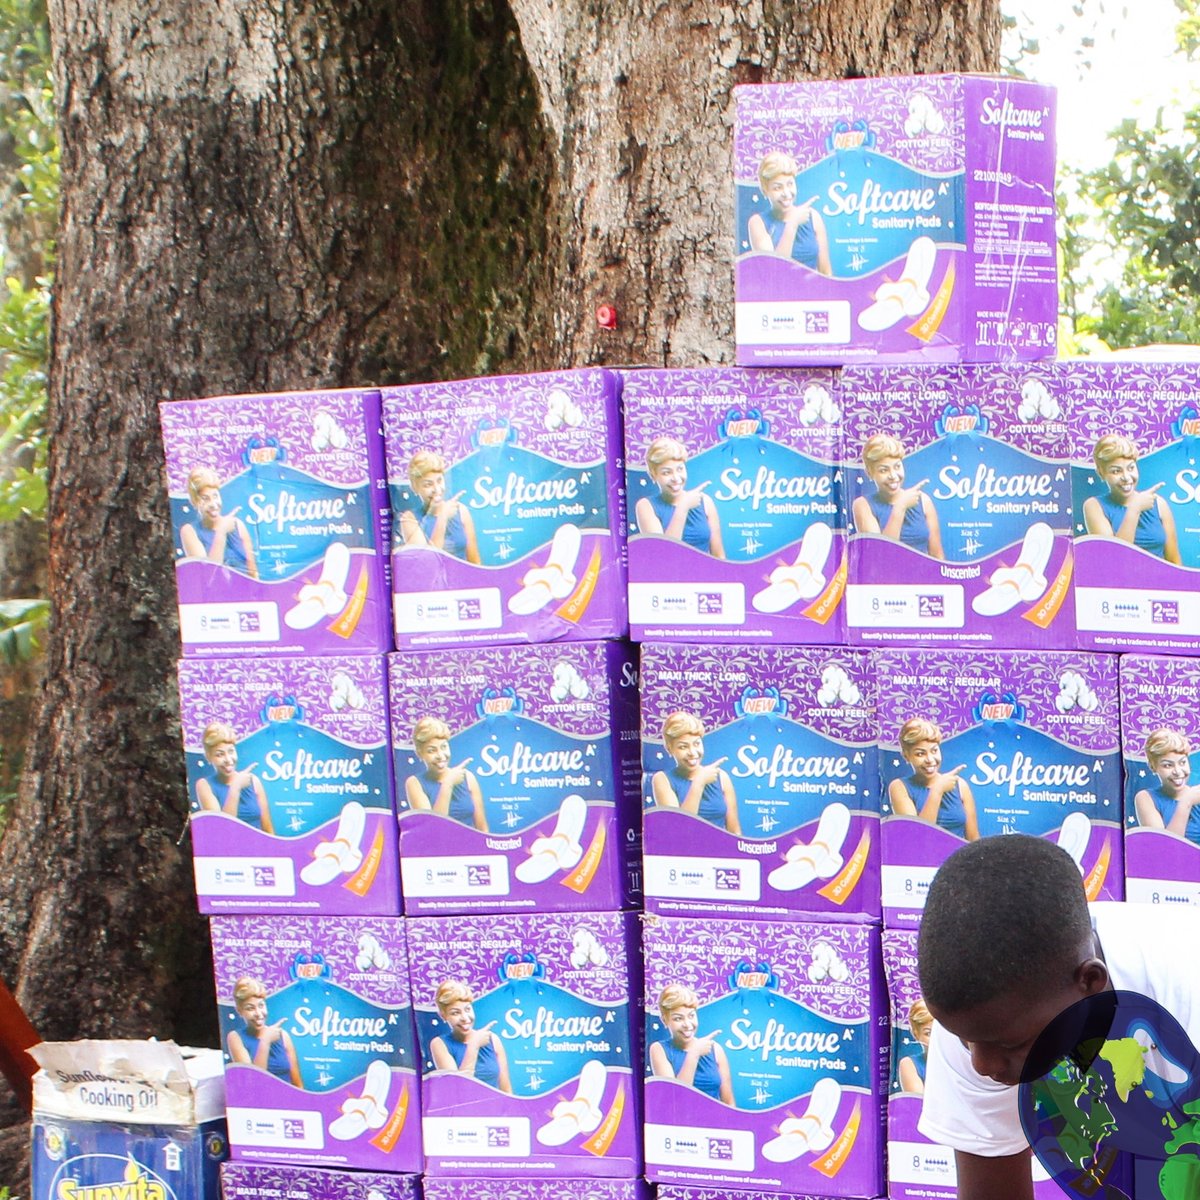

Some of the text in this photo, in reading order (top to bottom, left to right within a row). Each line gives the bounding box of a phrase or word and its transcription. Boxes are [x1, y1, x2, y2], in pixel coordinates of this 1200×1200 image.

[980, 97, 1043, 127] Softcare
[823, 178, 936, 225] Softcare
[872, 215, 942, 231] Sanitary Pads
[944, 415, 976, 433] NEW
[470, 471, 578, 516] Softcare
[715, 465, 832, 511] Softcare
[933, 462, 1053, 510] Softcare
[246, 489, 345, 533] Softcare
[766, 501, 838, 517] Sanitary Pads
[986, 500, 1059, 516] Sanitary Pads
[940, 565, 981, 580] Unscented
[981, 703, 1013, 720] NEW
[262, 747, 362, 790] Softcare
[476, 741, 584, 785] Softcare
[731, 743, 851, 788] Softcare
[969, 750, 1090, 797] Softcare
[524, 774, 591, 790] Sanitary Pads
[783, 781, 856, 797] Sanitary Pads
[1023, 790, 1097, 805] Sanitary Pads
[486, 837, 521, 850] Unscented
[738, 840, 777, 855] Unscented
[291, 1005, 388, 1046] Softcare
[498, 1005, 604, 1049] Softcare
[545, 1040, 611, 1055] Sanitary Pads
[725, 1017, 841, 1062] Softcare
[776, 1055, 846, 1071] Sanitary Pads
[80, 1087, 158, 1112] Cooking Oil
